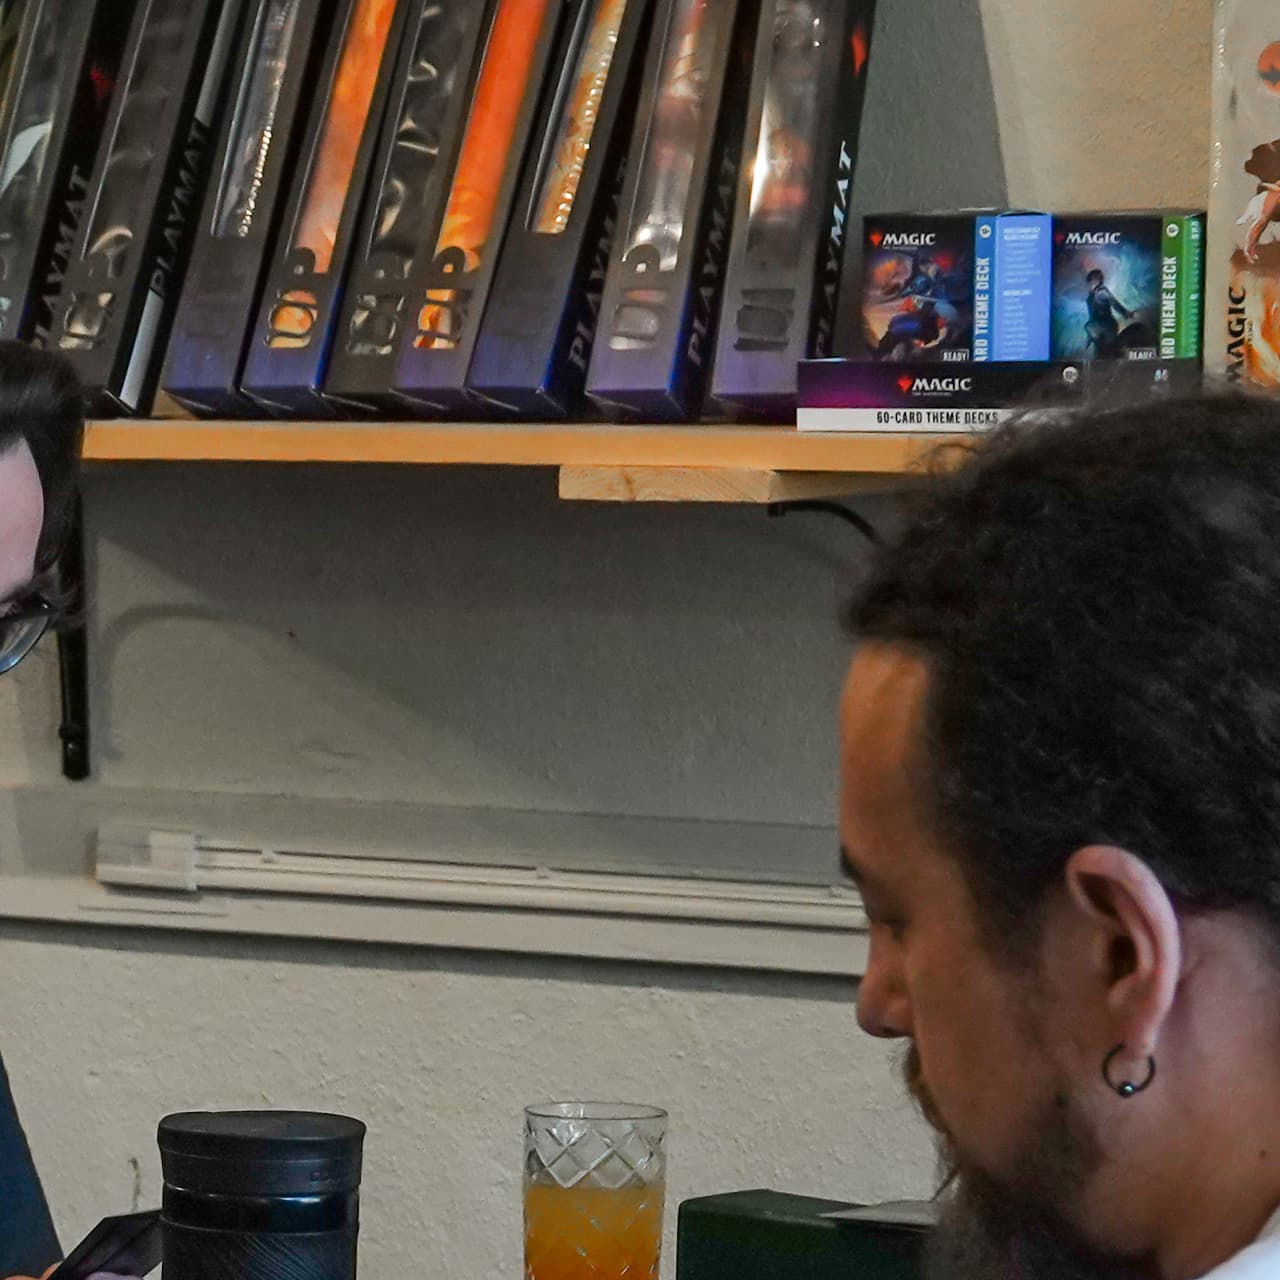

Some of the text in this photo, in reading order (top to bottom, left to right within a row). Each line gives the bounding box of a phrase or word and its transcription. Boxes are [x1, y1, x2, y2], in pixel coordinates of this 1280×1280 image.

[151, 119, 213, 298] PLAYMAT
[882, 232, 936, 246] MAGIC
[1065, 231, 1122, 245] MAGIC
[975, 257, 990, 290] DECK
[1162, 256, 1177, 289] DECK
[975, 292, 989, 336] THEME
[1161, 292, 1176, 334] THEME
[911, 377, 972, 392] MAGIC
[876, 411, 999, 425] 60-CARD THEME DECKS
